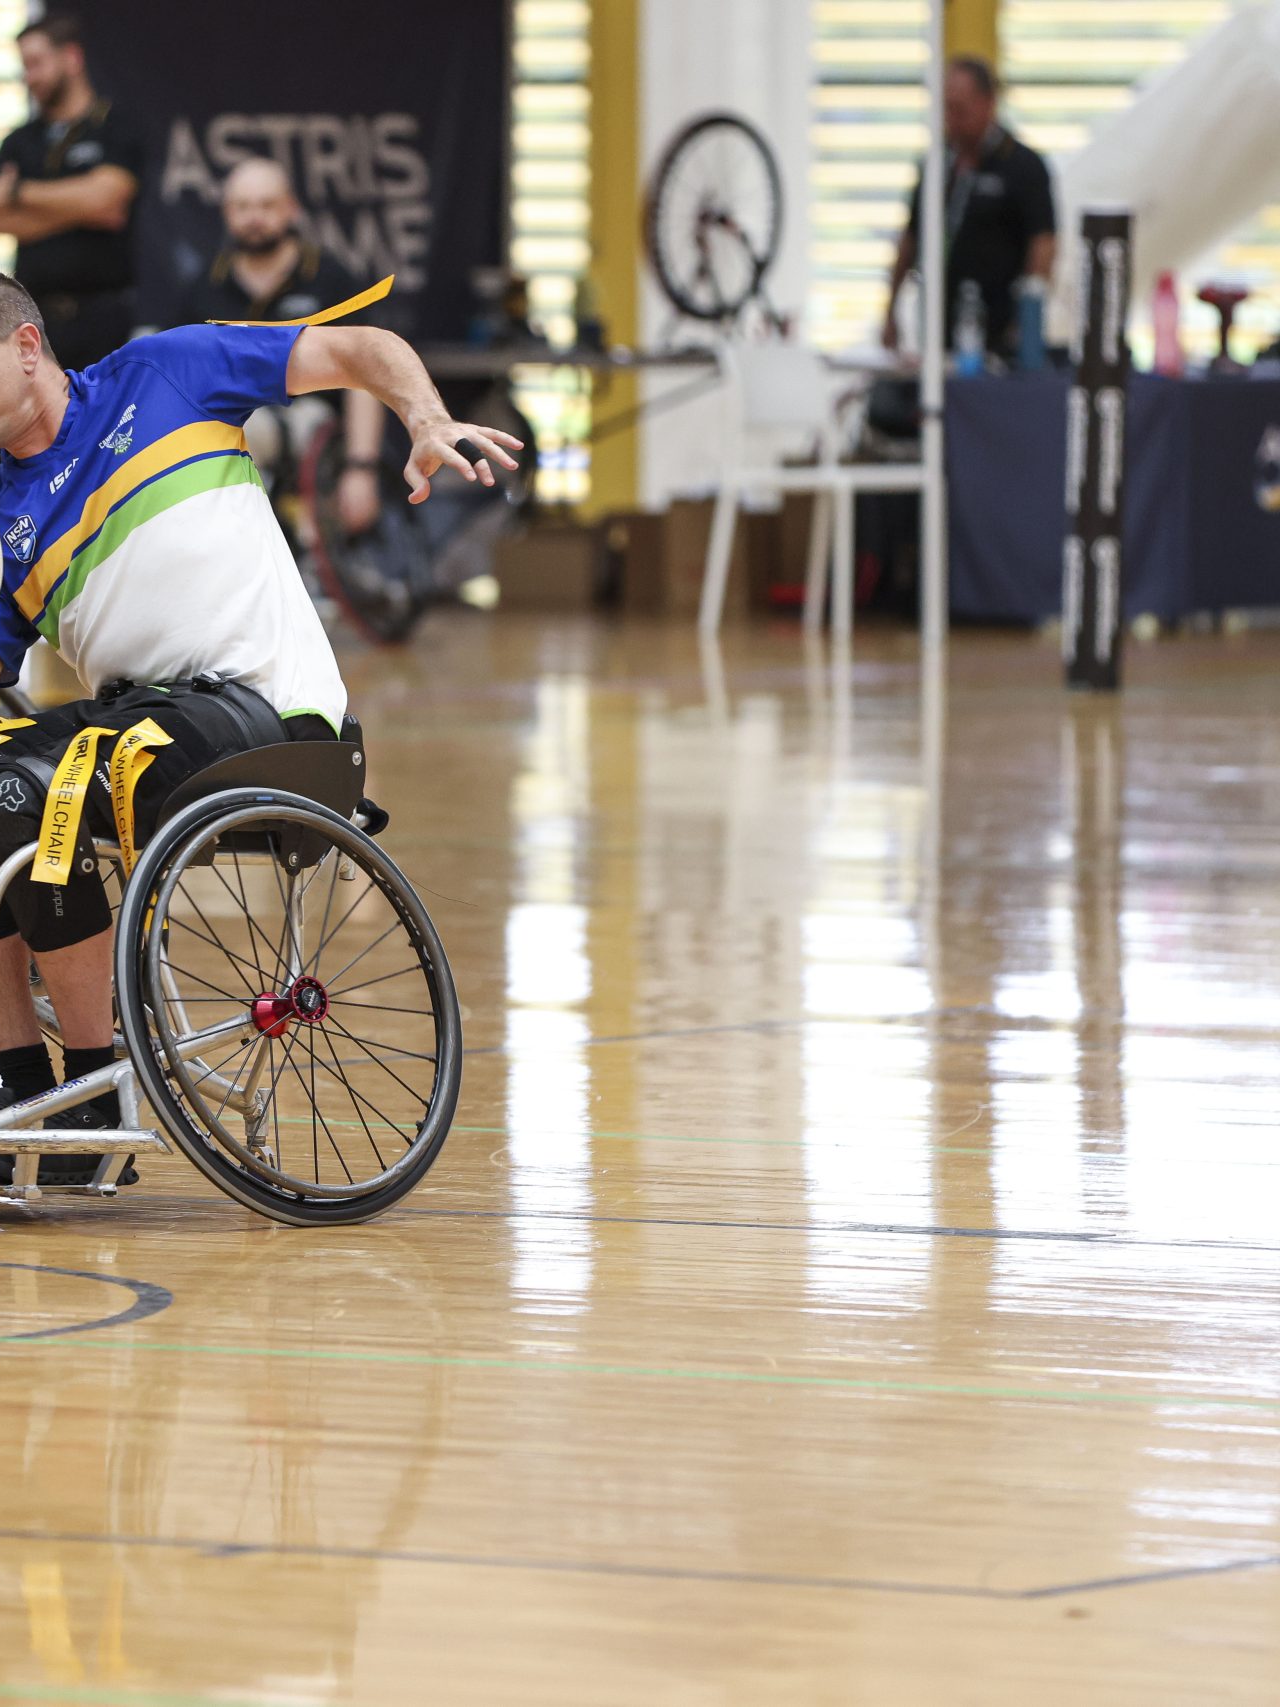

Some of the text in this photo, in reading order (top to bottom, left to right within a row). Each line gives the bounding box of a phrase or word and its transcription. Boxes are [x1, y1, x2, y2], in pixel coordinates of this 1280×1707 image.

[49, 463, 73, 495] ISC
[6, 517, 30, 544] NSW
[44, 734, 92, 867] NRL WHEELCHAIR
[115, 754, 133, 873] WHEELCHAIR
